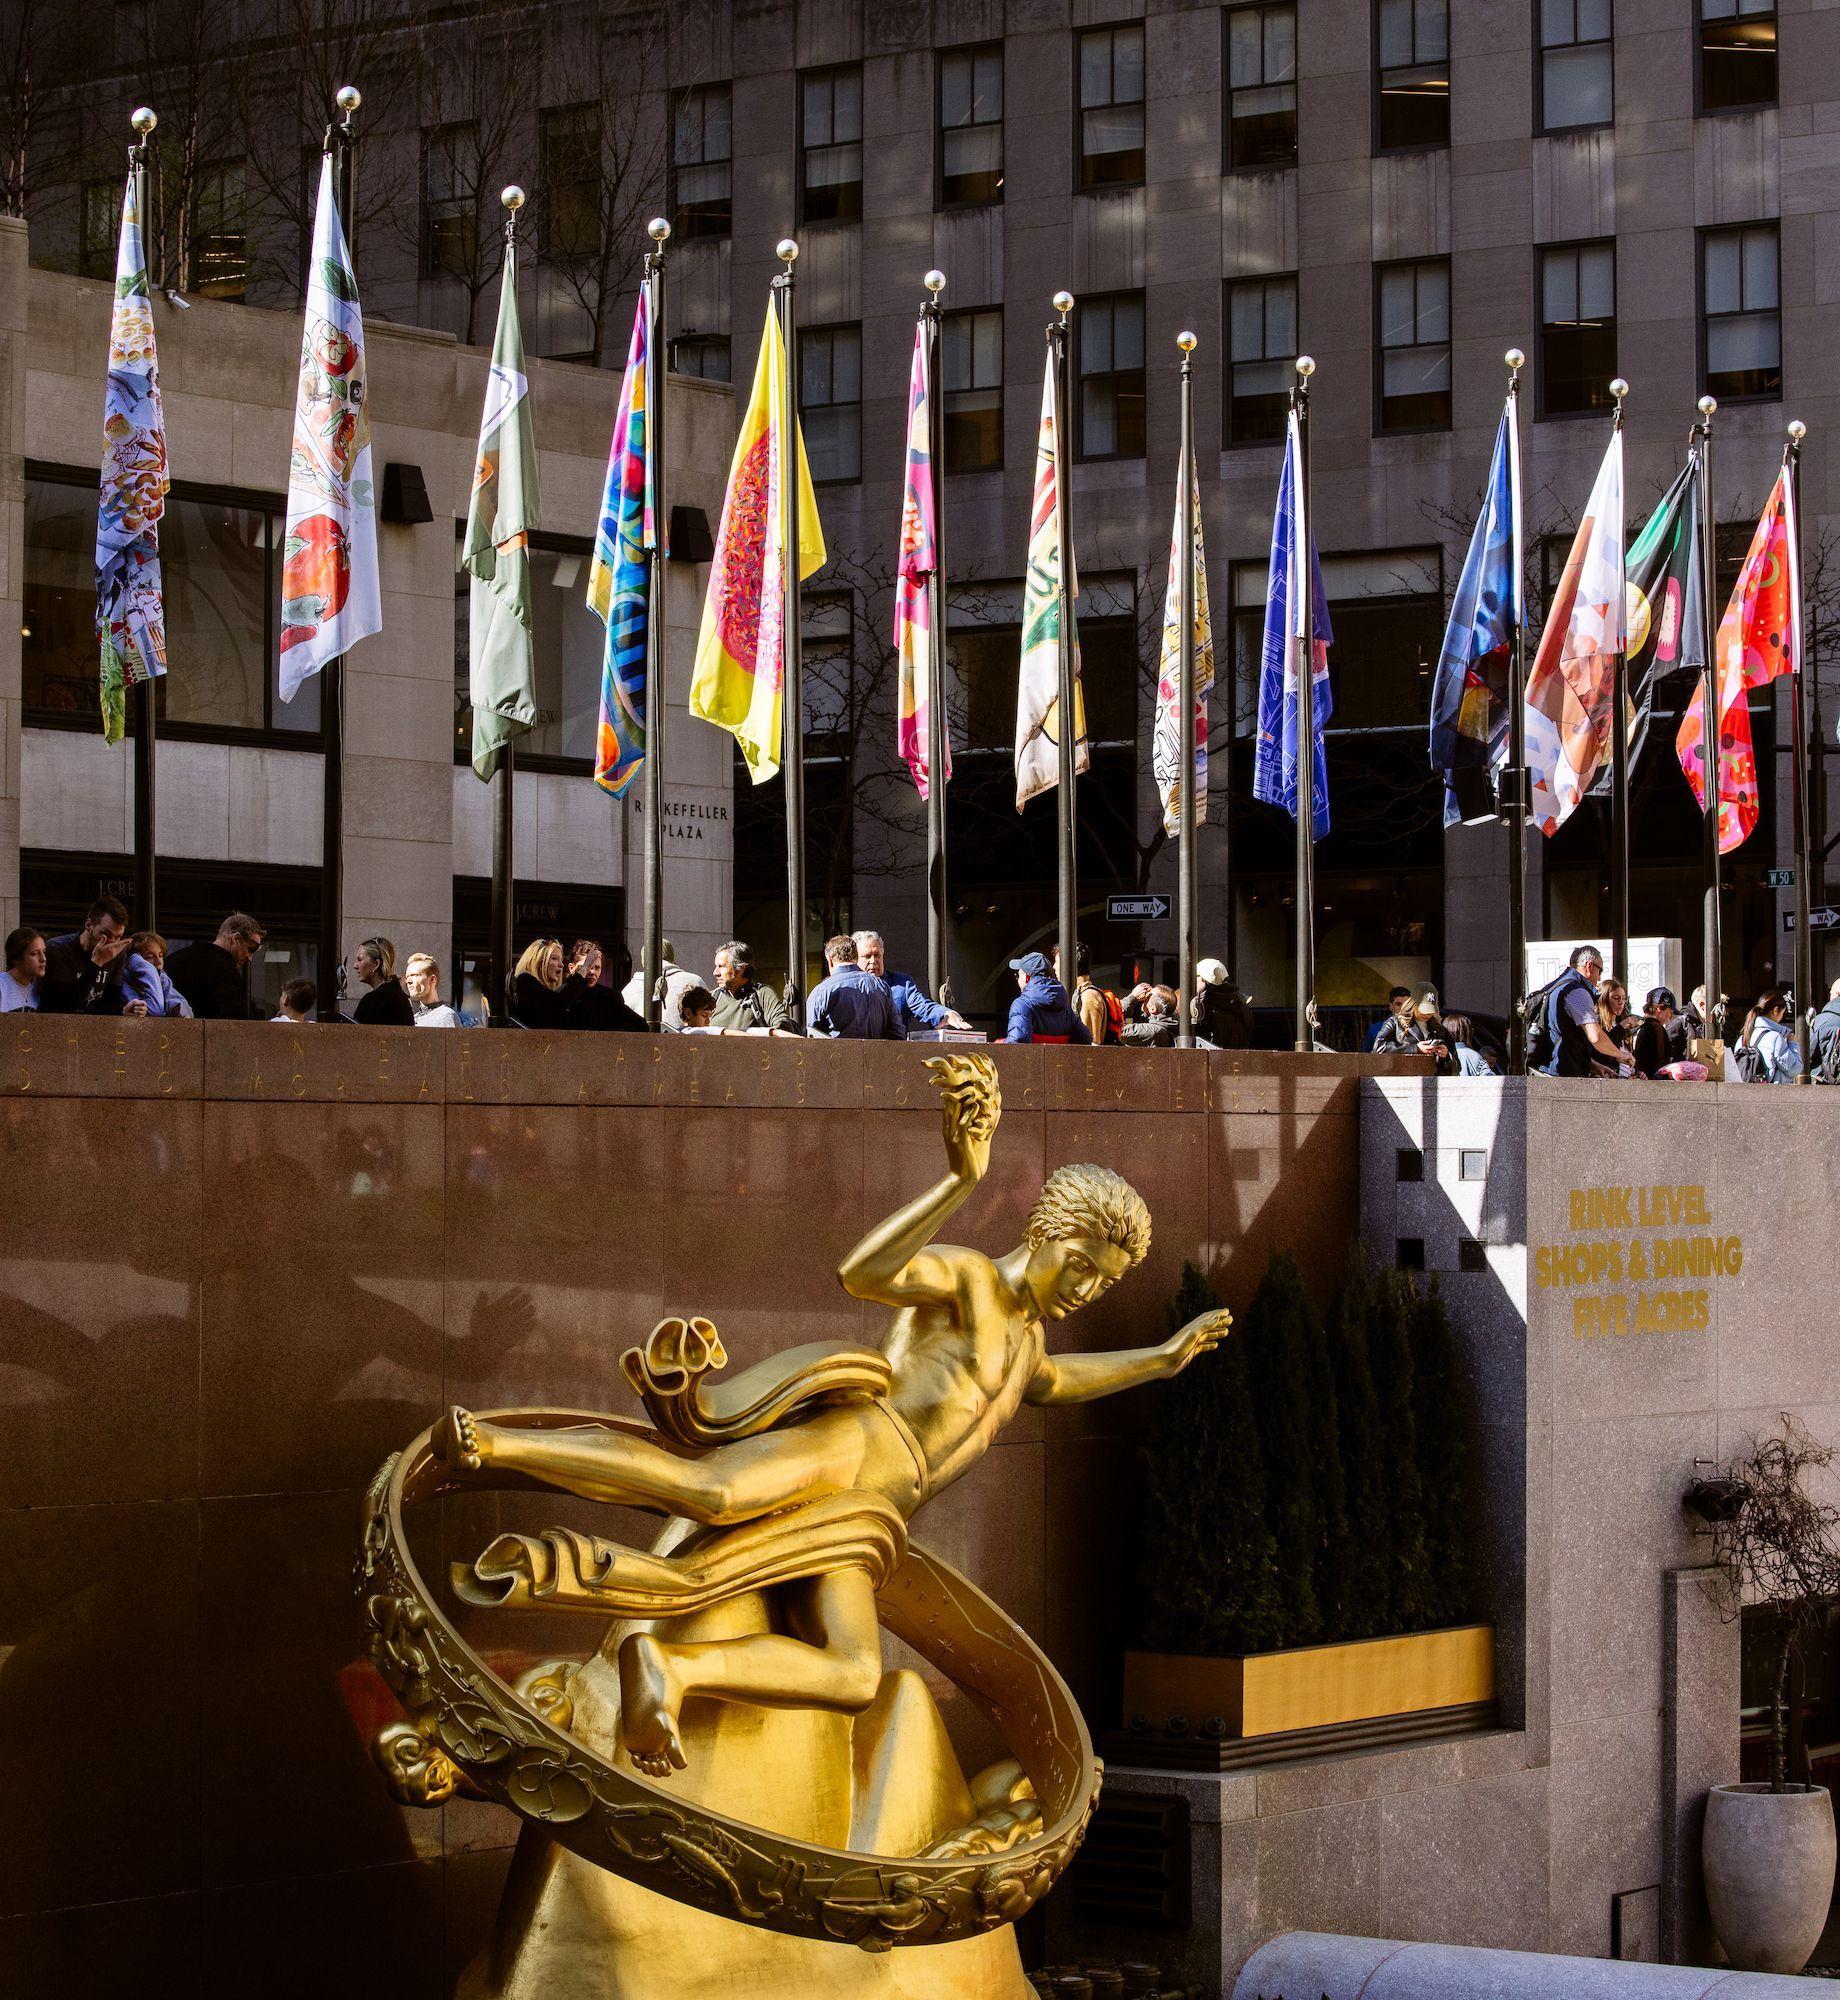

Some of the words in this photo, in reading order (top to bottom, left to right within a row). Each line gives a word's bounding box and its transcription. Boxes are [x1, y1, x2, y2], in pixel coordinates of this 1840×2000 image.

[634, 800, 728, 820] RKEFELLER
[662, 824, 703, 839] PLAZA
[1769, 872, 1777, 885] W
[1779, 871, 1790, 885] 50
[99, 879, 137, 899] J.CRE
[1116, 903, 1135, 913] ONE
[1142, 903, 1161, 913] WAY
[1816, 912, 1834, 923] WAY
[1569, 1185, 1633, 1231] RINK
[1638, 1184, 1712, 1227] LEVEL
[1535, 1241, 1625, 1289] SHOPS
[1628, 1239, 1648, 1281] &
[1653, 1235, 1743, 1279] DINING
[1573, 1295, 1629, 1339] FIVE
[1634, 1289, 1710, 1335] ACRES
